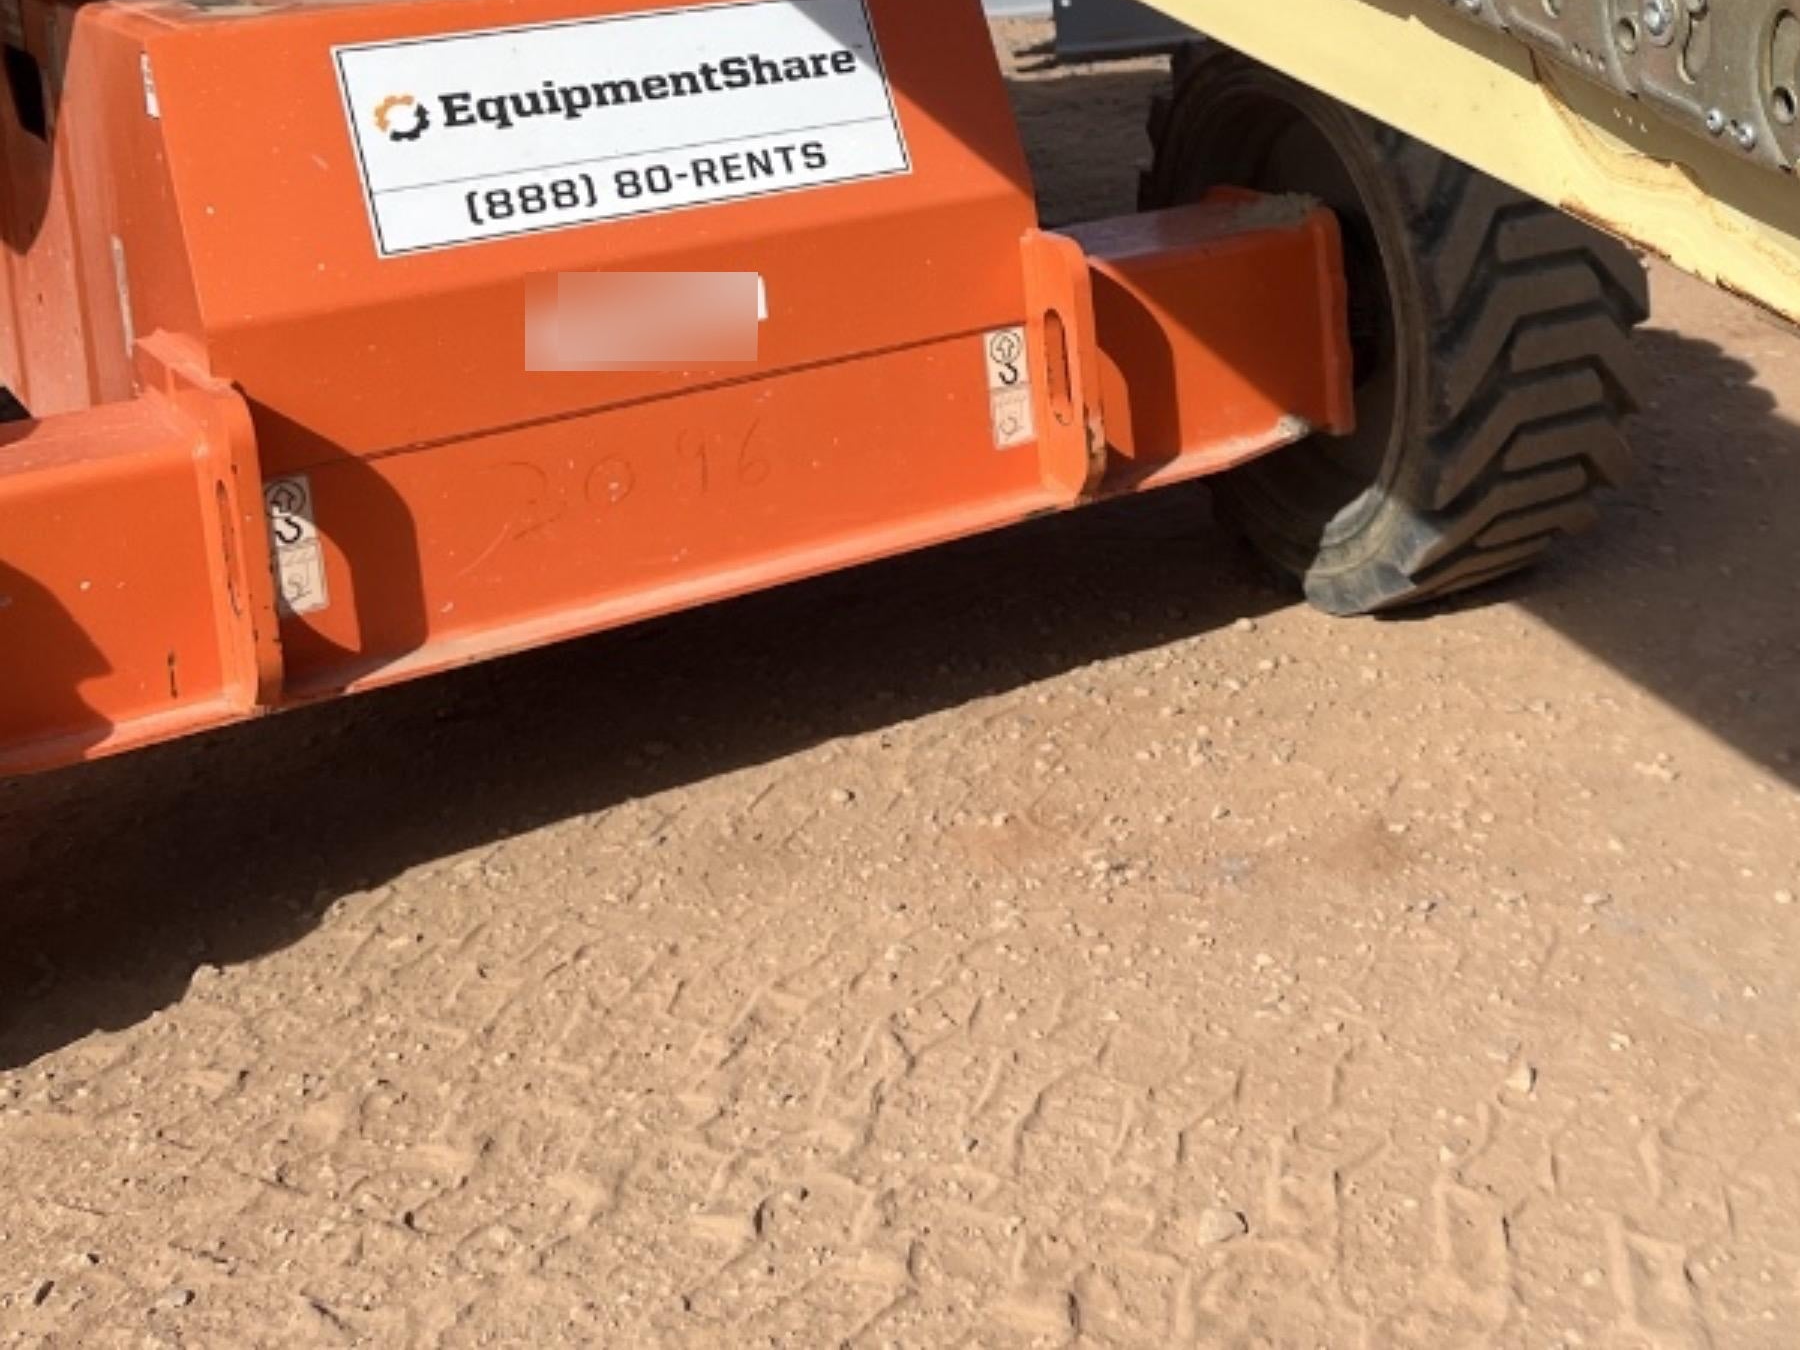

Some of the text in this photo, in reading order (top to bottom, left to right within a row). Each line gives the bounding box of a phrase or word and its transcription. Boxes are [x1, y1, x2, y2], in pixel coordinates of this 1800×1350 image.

[439, 46, 858, 129] EquipmentShare
[465, 141, 829, 227] (888) 80-RENTS
